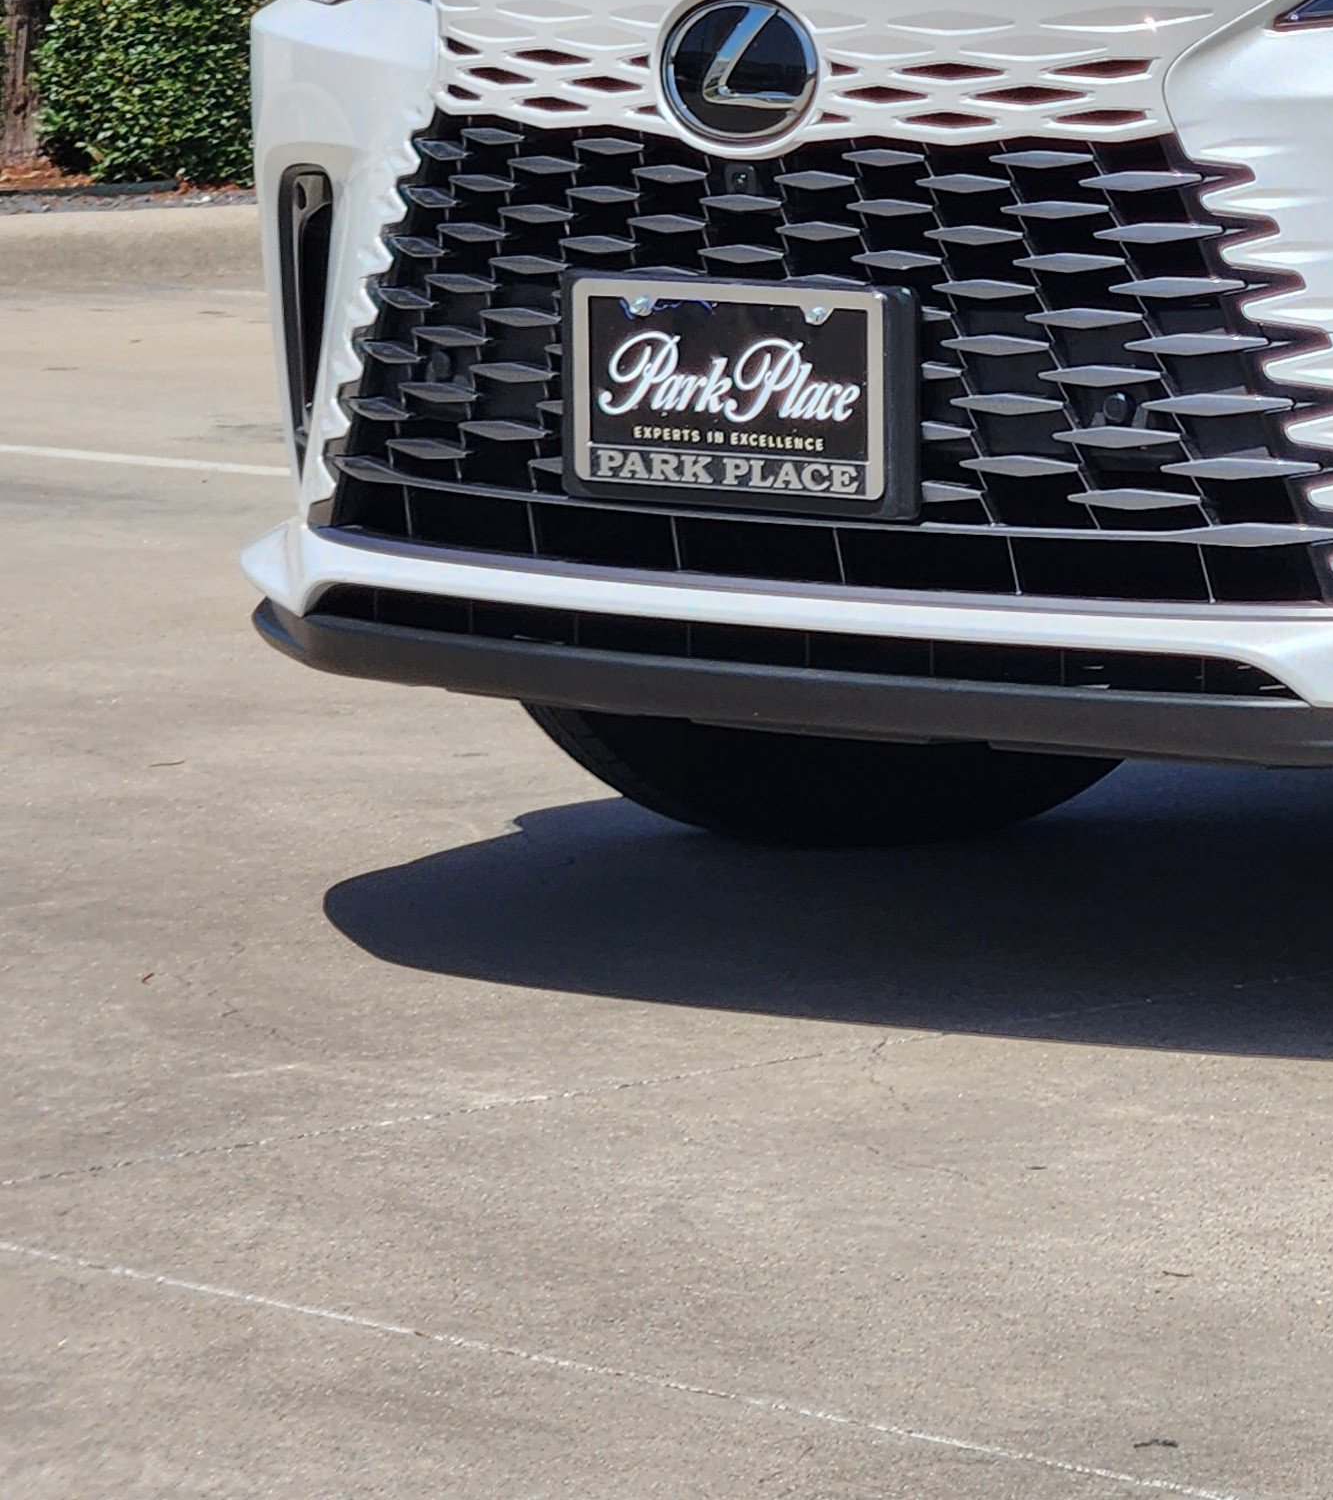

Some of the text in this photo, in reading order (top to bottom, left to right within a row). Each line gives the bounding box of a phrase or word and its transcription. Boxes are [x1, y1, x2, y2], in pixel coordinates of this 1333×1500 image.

[598, 330, 862, 424] Park Place
[632, 425, 826, 452] EXPERTS IN EXCELLENCE
[595, 449, 862, 496] PARK PLACE
